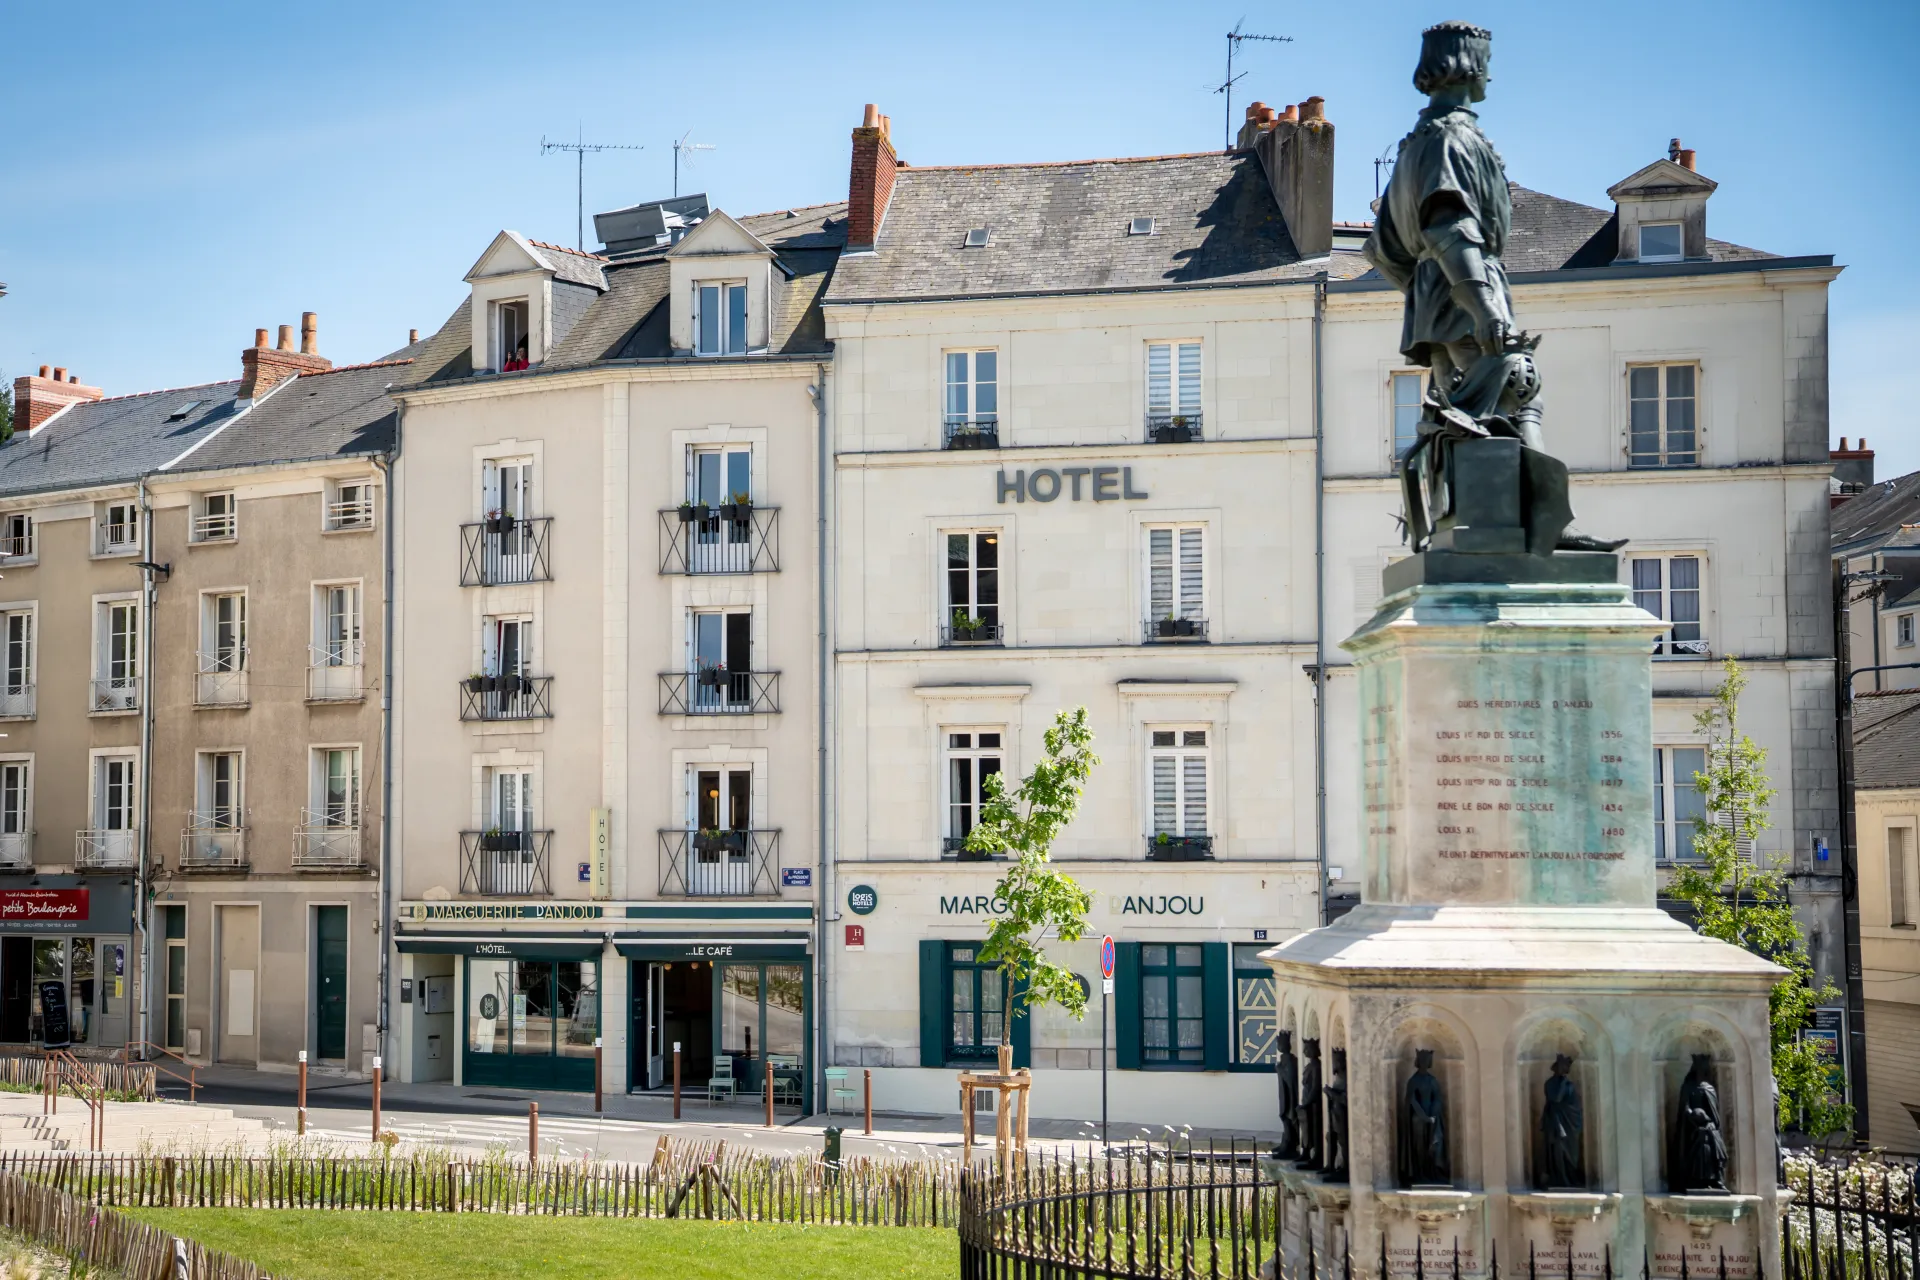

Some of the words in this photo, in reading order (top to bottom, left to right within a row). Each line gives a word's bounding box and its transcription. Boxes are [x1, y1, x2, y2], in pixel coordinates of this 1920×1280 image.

[996, 467, 1148, 504] HOTEL
[1436, 755, 1461, 763] LOUIS
[1504, 755, 1514, 763] DE
[1518, 755, 1545, 763] SICILE
[1522, 779, 1549, 787] SICILE
[1477, 803, 1493, 811] BON
[1498, 803, 1512, 811] ROI
[1516, 803, 1526, 811] DE
[1529, 803, 1554, 811] SICILE
[3, 900, 24, 917] petite
[27, 901, 78, 918] Boulangerie
[433, 904, 524, 920] MARGUERITE
[536, 904, 595, 920] D'ANJOU
[854, 929, 862, 937] H
[1256, 931, 1265, 939] 15
[706, 945, 733, 956] CAFÉ
[1571, 1252, 1599, 1260] LAVAL
[1655, 1253, 1702, 1262] MARGURITE
[1695, 1266, 1749, 1275] ANGLEERRE
